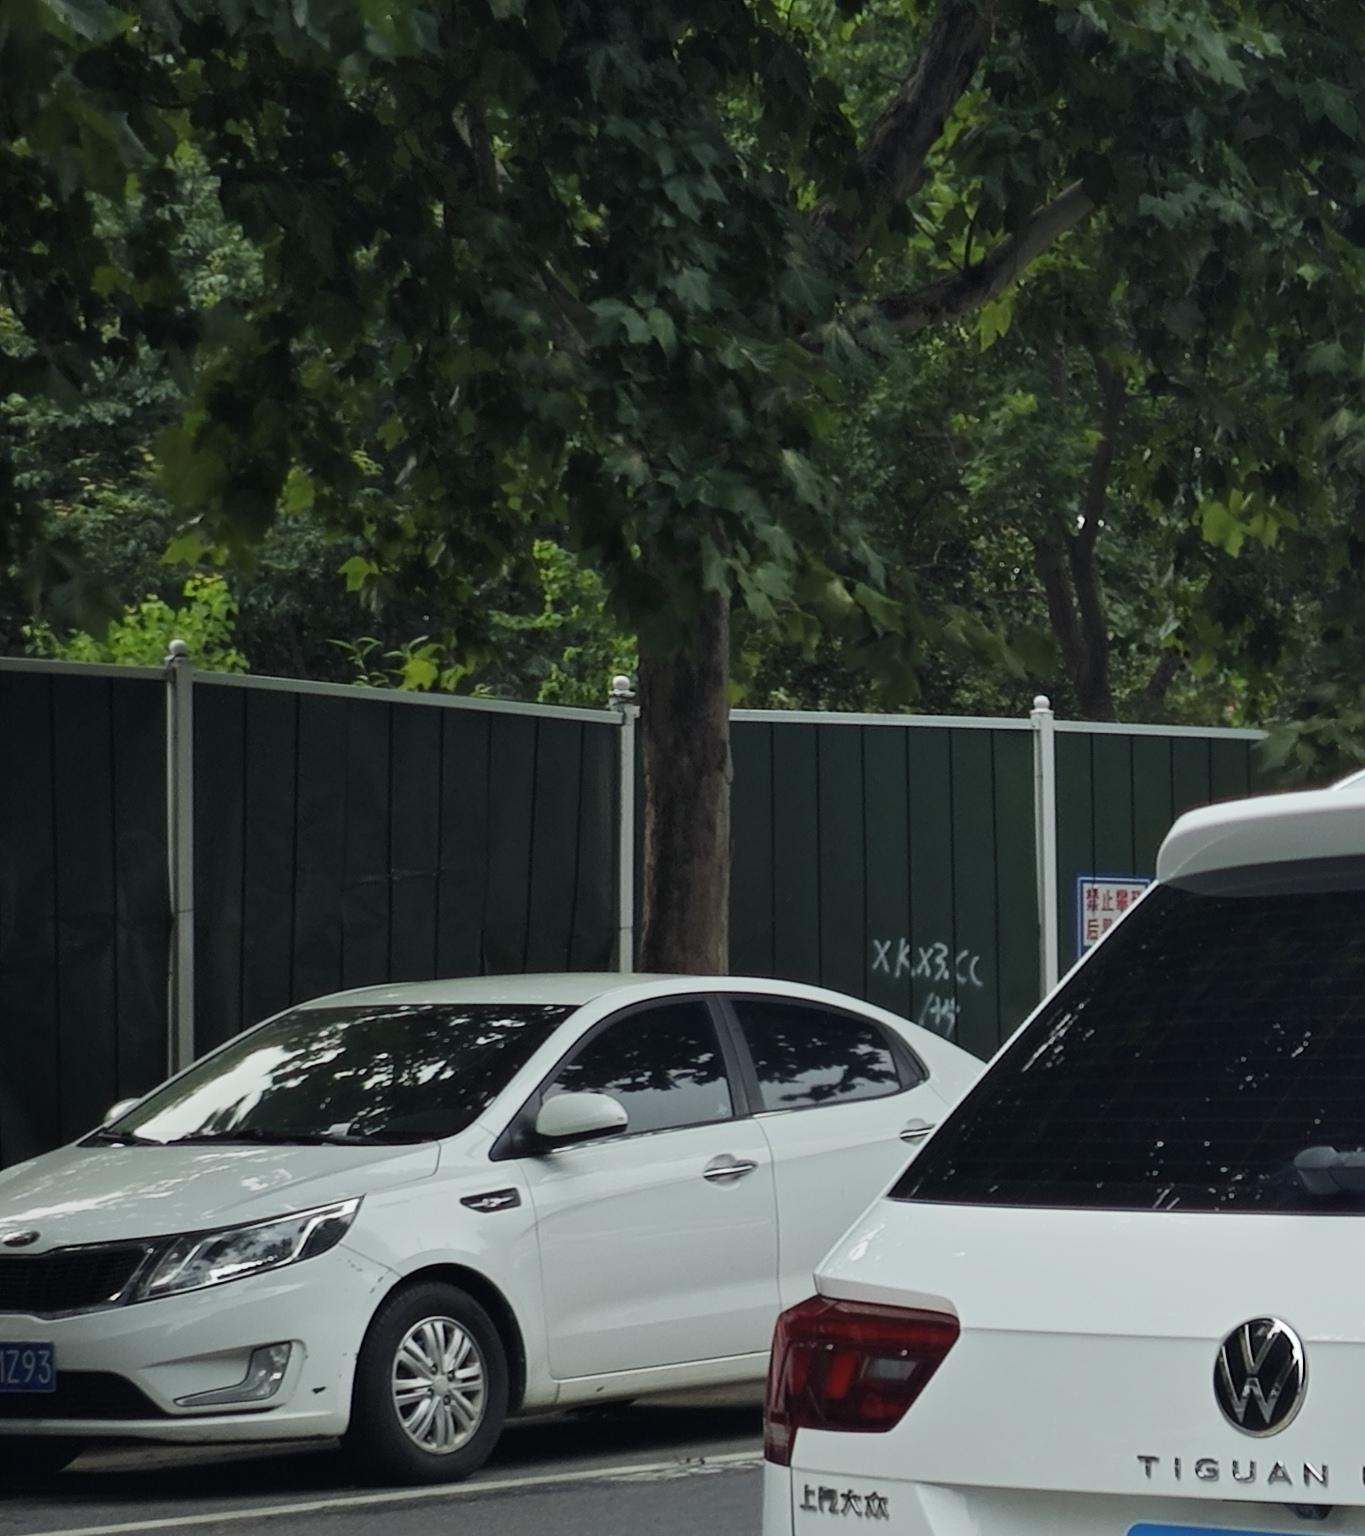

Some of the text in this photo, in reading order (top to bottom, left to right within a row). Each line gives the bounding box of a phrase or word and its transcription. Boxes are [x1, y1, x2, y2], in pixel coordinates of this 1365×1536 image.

[1136, 1454, 1329, 1490] TIGUAN
[799, 1483, 891, 1520] 上汽大众
